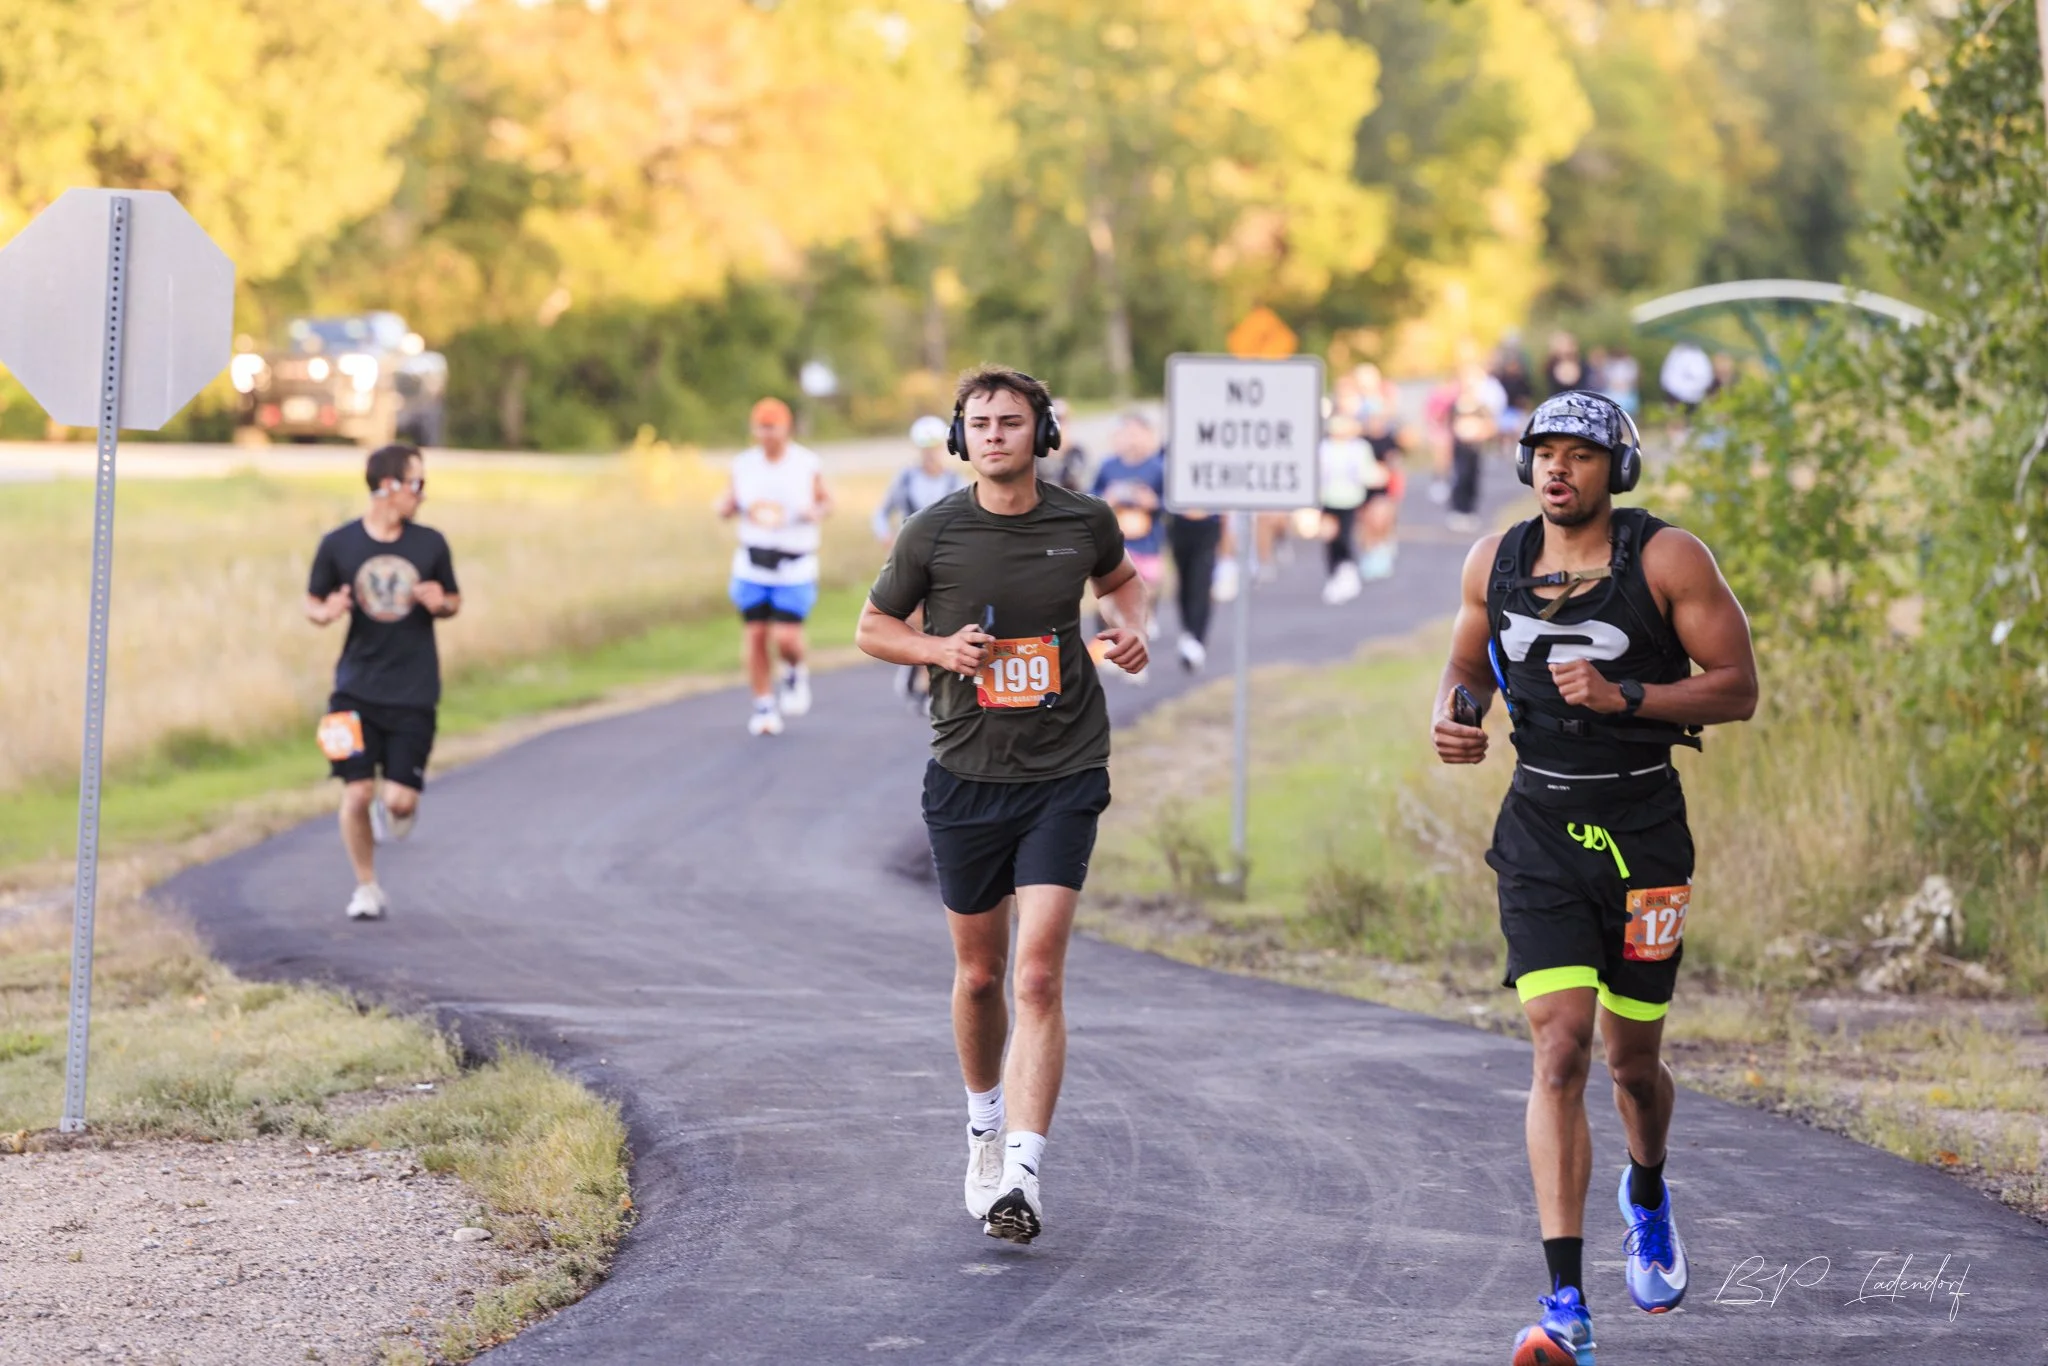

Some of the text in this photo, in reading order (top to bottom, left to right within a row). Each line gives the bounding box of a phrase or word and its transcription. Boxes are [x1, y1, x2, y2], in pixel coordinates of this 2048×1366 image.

[1226, 378, 1264, 406] NO
[1196, 420, 1293, 448] MOTOR
[1191, 462, 1299, 491] VEHICLES
[988, 656, 1050, 693] 199
